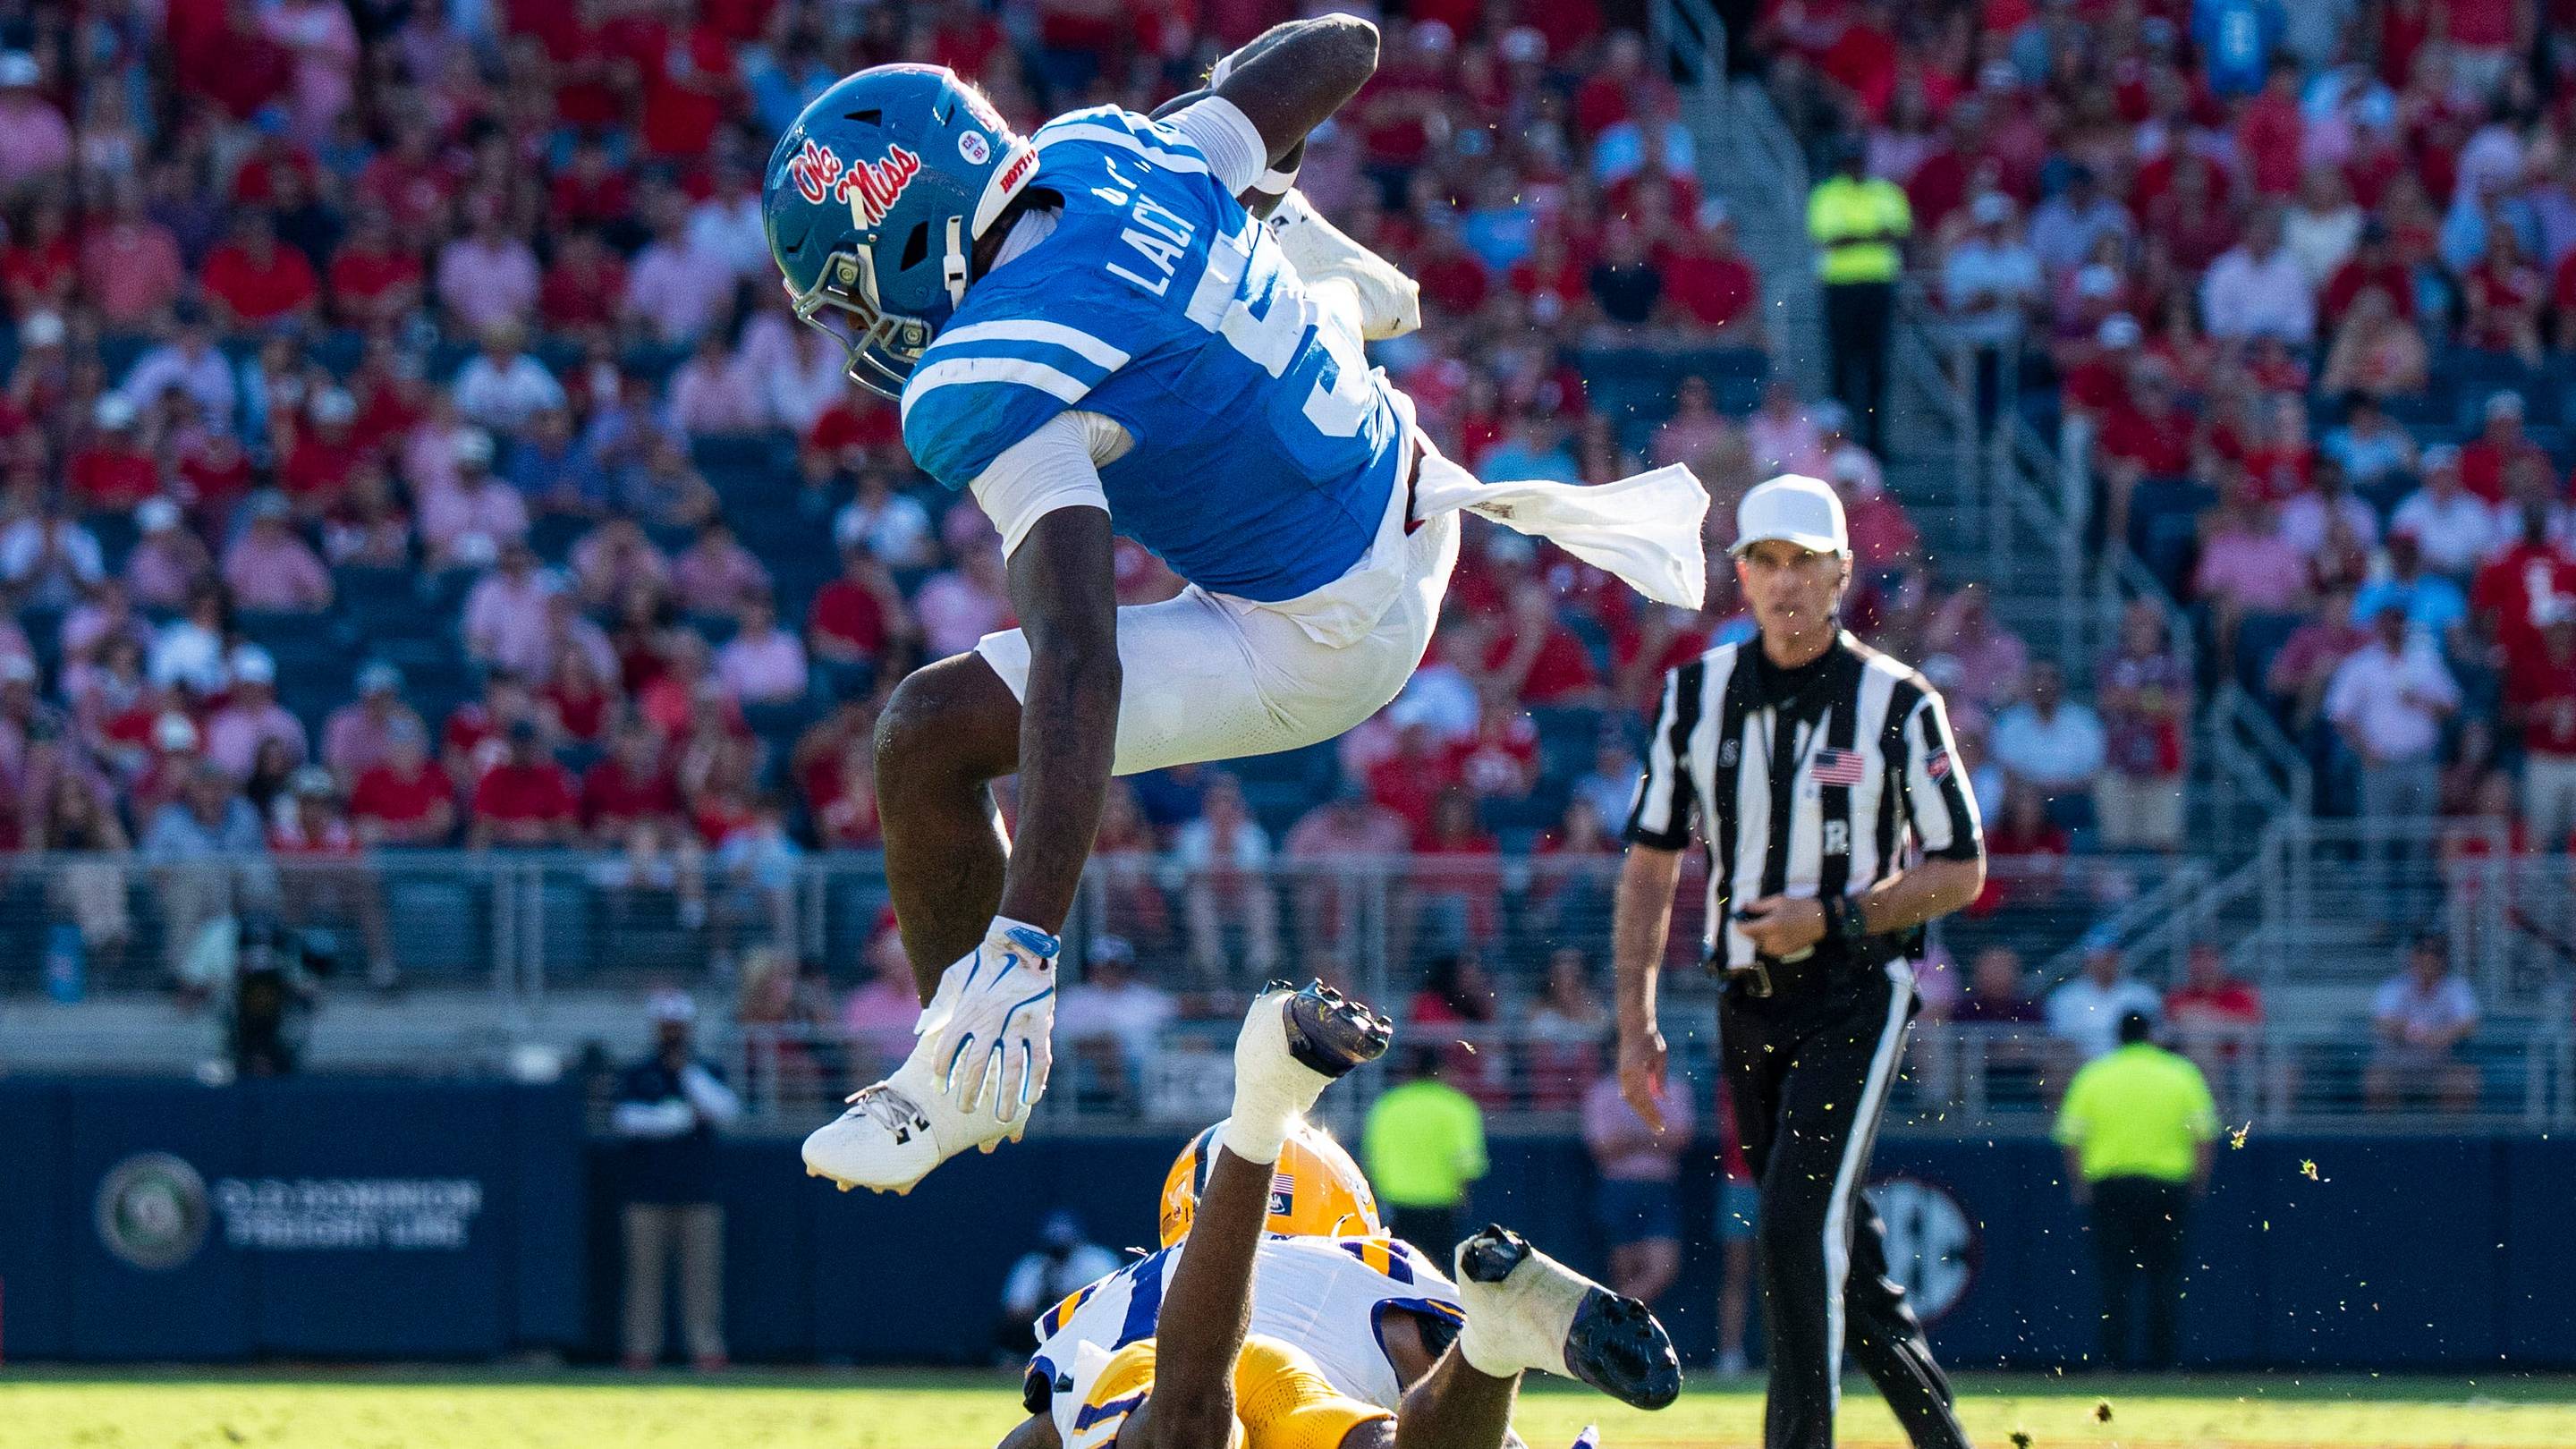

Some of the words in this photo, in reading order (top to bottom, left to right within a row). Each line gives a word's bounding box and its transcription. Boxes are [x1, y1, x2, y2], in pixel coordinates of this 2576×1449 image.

[793, 140, 843, 204] Ole
[835, 143, 922, 226] Miss
[1106, 193, 1196, 297] LACY
[1184, 229, 1377, 438] 5
[1824, 819, 1849, 854] R
